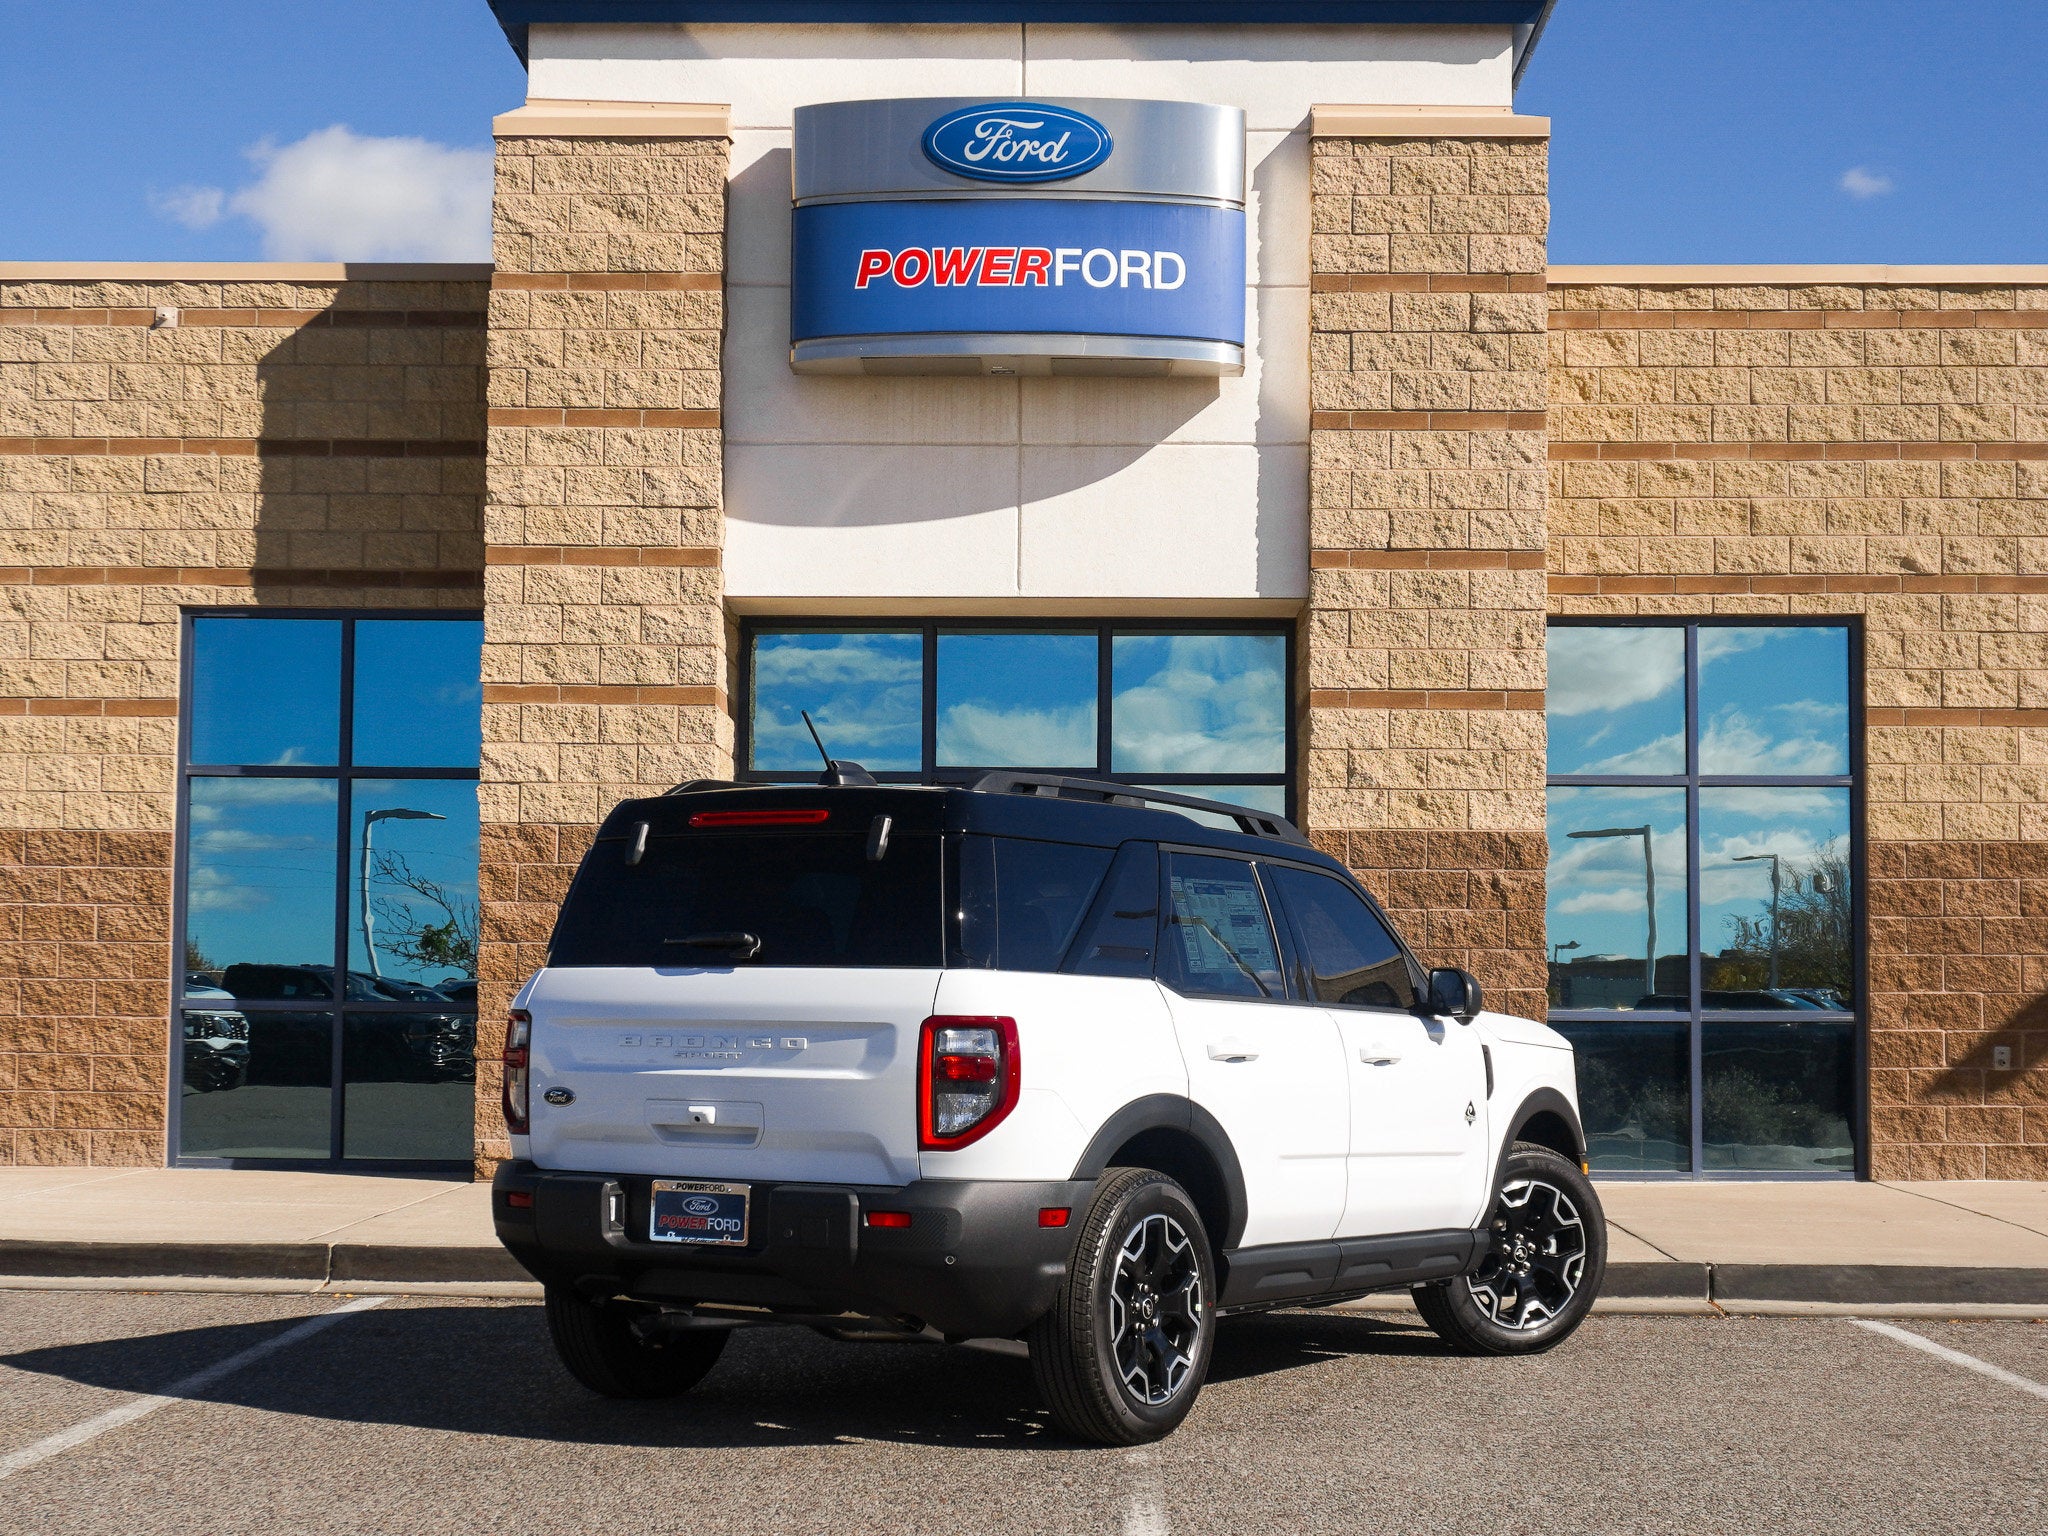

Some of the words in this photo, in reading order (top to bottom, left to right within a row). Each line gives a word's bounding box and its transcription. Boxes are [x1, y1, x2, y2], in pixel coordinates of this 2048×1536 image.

[964, 118, 1071, 164] Ford
[854, 247, 1187, 290] POWERFORD
[618, 1034, 808, 1050] BRONCO
[674, 1050, 743, 1060] SPORT
[548, 1090, 568, 1103] Ford
[676, 1182, 726, 1193] POWERFORD
[689, 1199, 712, 1212] Ford
[658, 1214, 741, 1232] POWERFORD
